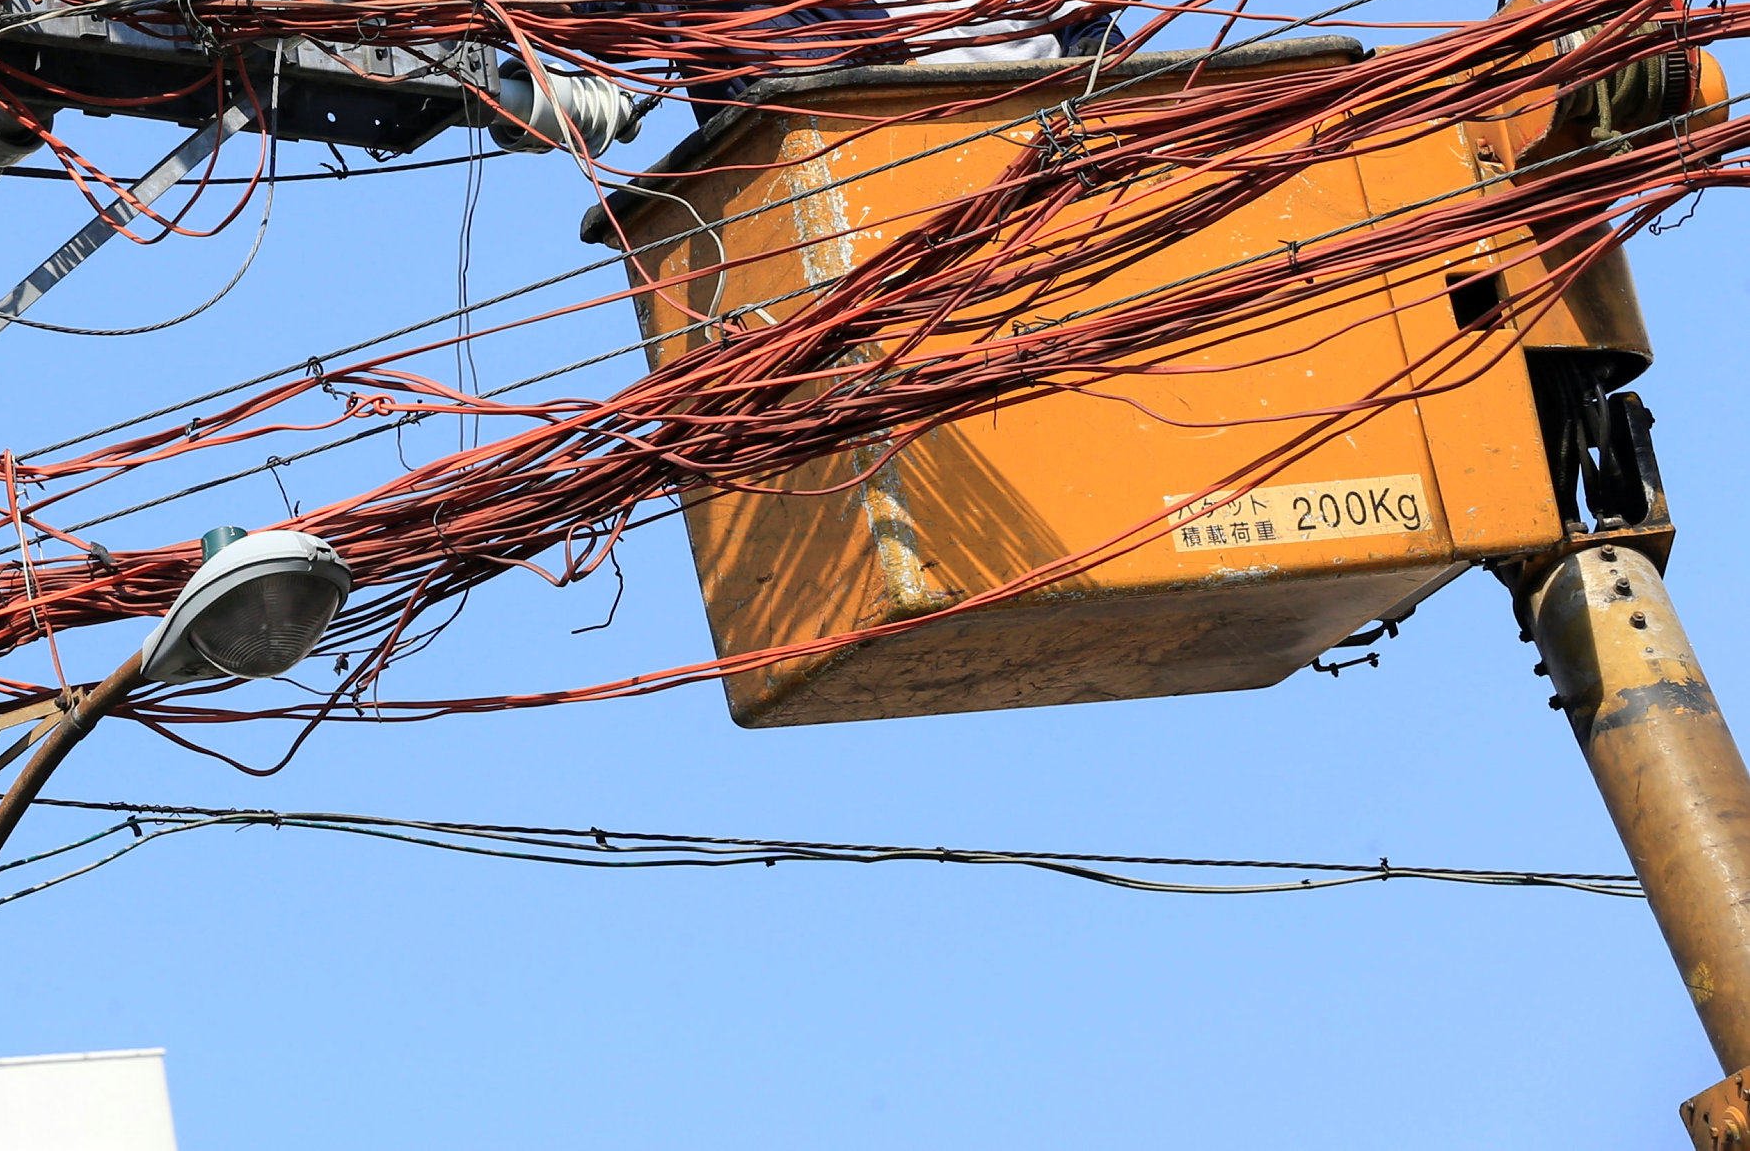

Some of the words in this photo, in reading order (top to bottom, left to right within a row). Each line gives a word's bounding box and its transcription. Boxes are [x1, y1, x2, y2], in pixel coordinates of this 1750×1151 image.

[1293, 487, 1421, 531] 200Kg
[1181, 519, 1277, 548] 積載荷重
